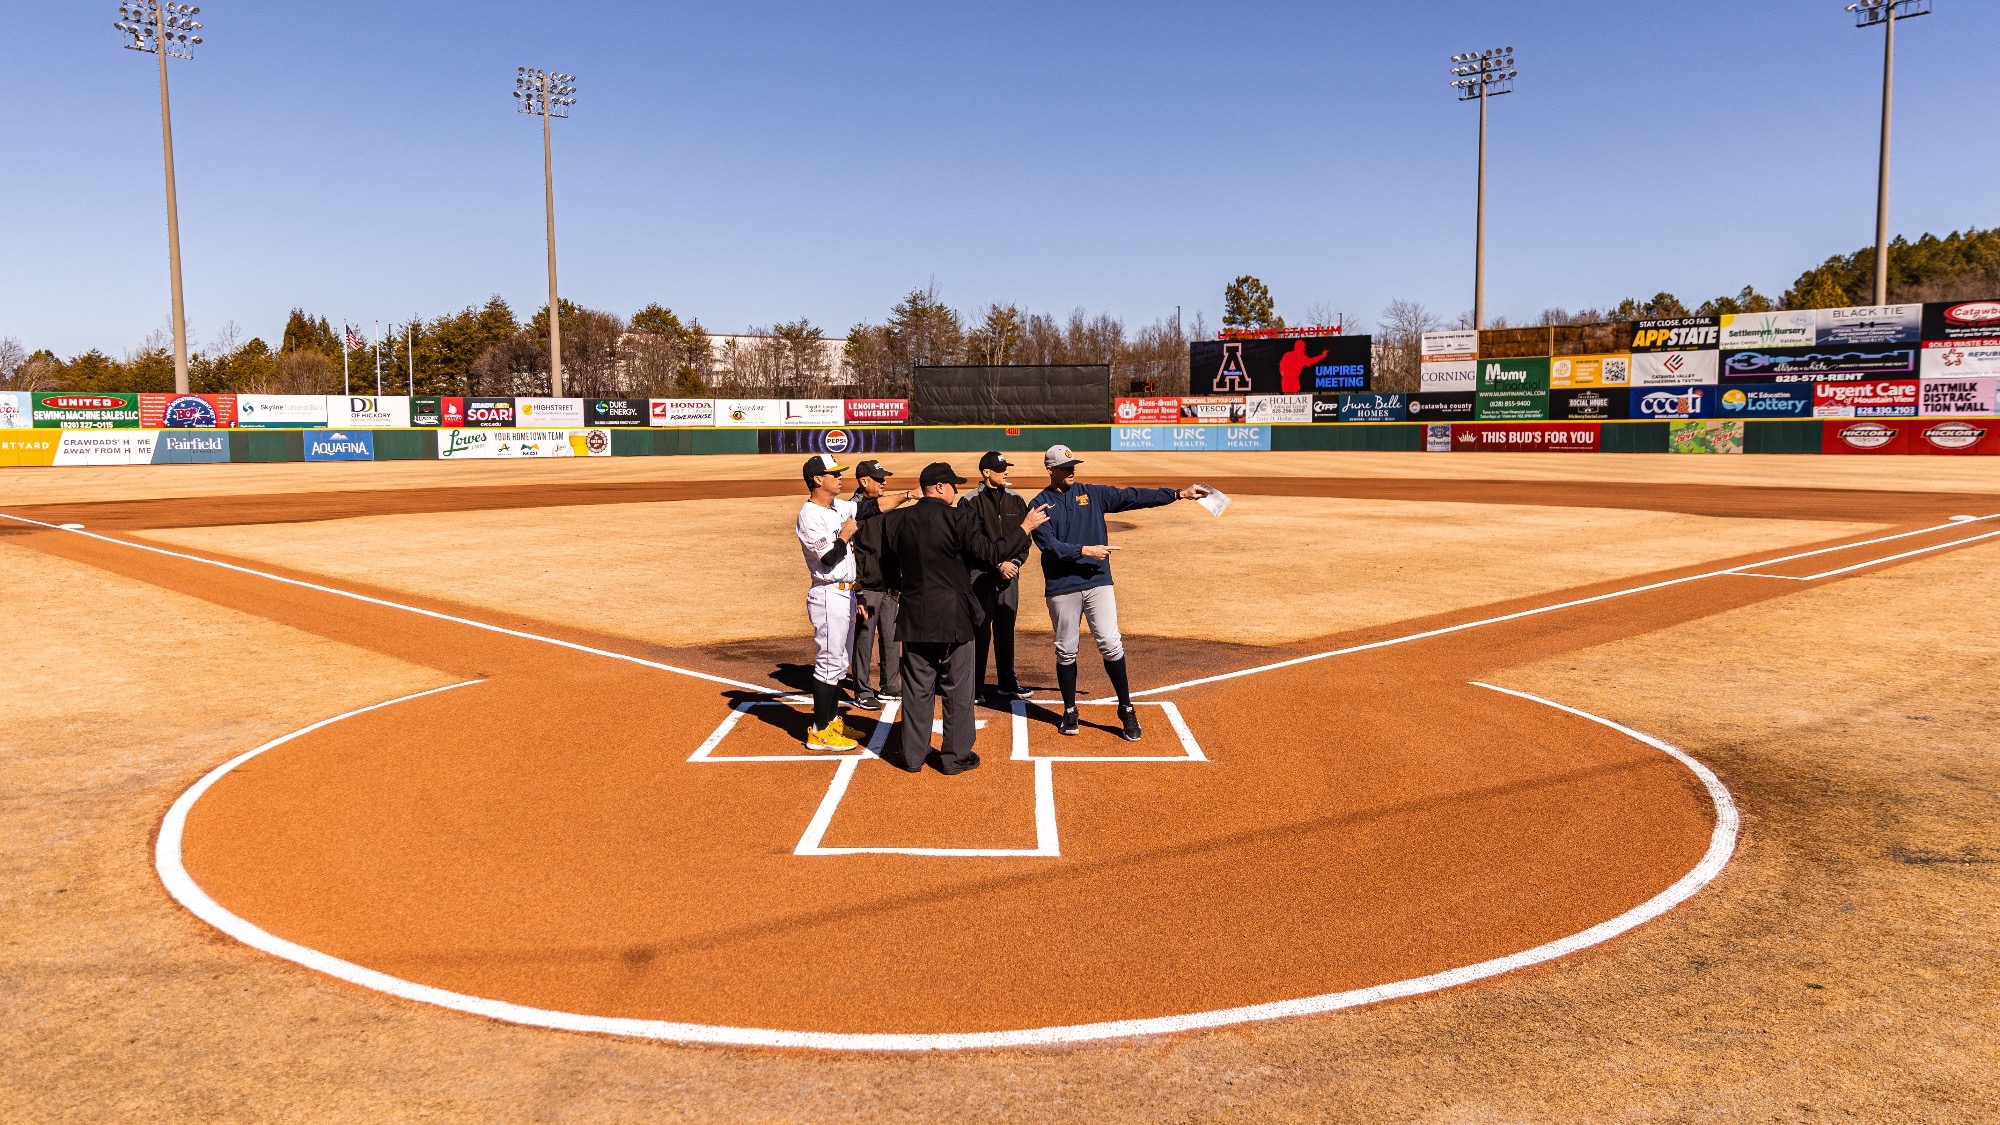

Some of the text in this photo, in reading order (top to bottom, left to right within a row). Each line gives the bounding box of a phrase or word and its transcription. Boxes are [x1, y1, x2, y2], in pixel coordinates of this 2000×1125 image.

[1833, 307, 1904, 318] BLACK TIE
[1639, 319, 1656, 328] STAY
[1656, 319, 1681, 327] CLOSE.
[1683, 318, 1695, 326] GO
[1283, 325, 1341, 337] STADIUM
[1729, 327, 1806, 338] Settlemyre Nursery
[1315, 365, 1364, 377] UMPIRES
[1421, 370, 1475, 382] CORNING
[1485, 363, 1527, 383] Mumy
[1315, 377, 1364, 388] MEETING
[1775, 373, 1864, 383] 828-578-RENT
[1817, 383, 1916, 402] Urgent Care
[1924, 382, 1978, 393] OATMILK
[1479, 390, 1546, 398] WWW.MUMYFINANCIAL.COM
[1924, 393, 1976, 403] DISTRAC-
[58, 398, 112, 407] UNITED
[609, 401, 627, 409] DUKE
[1269, 397, 1308, 405] HOLLAR
[1342, 395, 1402, 413] June Belle
[1421, 402, 1448, 410] catawba
[1450, 402, 1472, 410] county
[1569, 398, 1608, 407] SOCIAL HOUSE
[1747, 399, 1798, 413] Lottery
[1844, 396, 1853, 406] of
[260, 404, 284, 412] Skyline
[534, 404, 573, 412] HIGHSTREET
[1923, 403, 1950, 412] TION
[34, 411, 139, 421] SEWING MACHINE SALES LLC
[468, 408, 512, 421] SOAR!
[494, 431, 564, 441] YOUR HOMETOWN TEAM
[1119, 428, 1152, 440] UNC
[1174, 428, 1206, 440] UNC
[1227, 428, 1260, 440] UNC
[1482, 431, 1594, 444] THIS BUD'S FOR YOU
[2, 442, 50, 450] RTYARD
[167, 438, 222, 451] Fairfield
[312, 442, 370, 456] AQUAFINA
